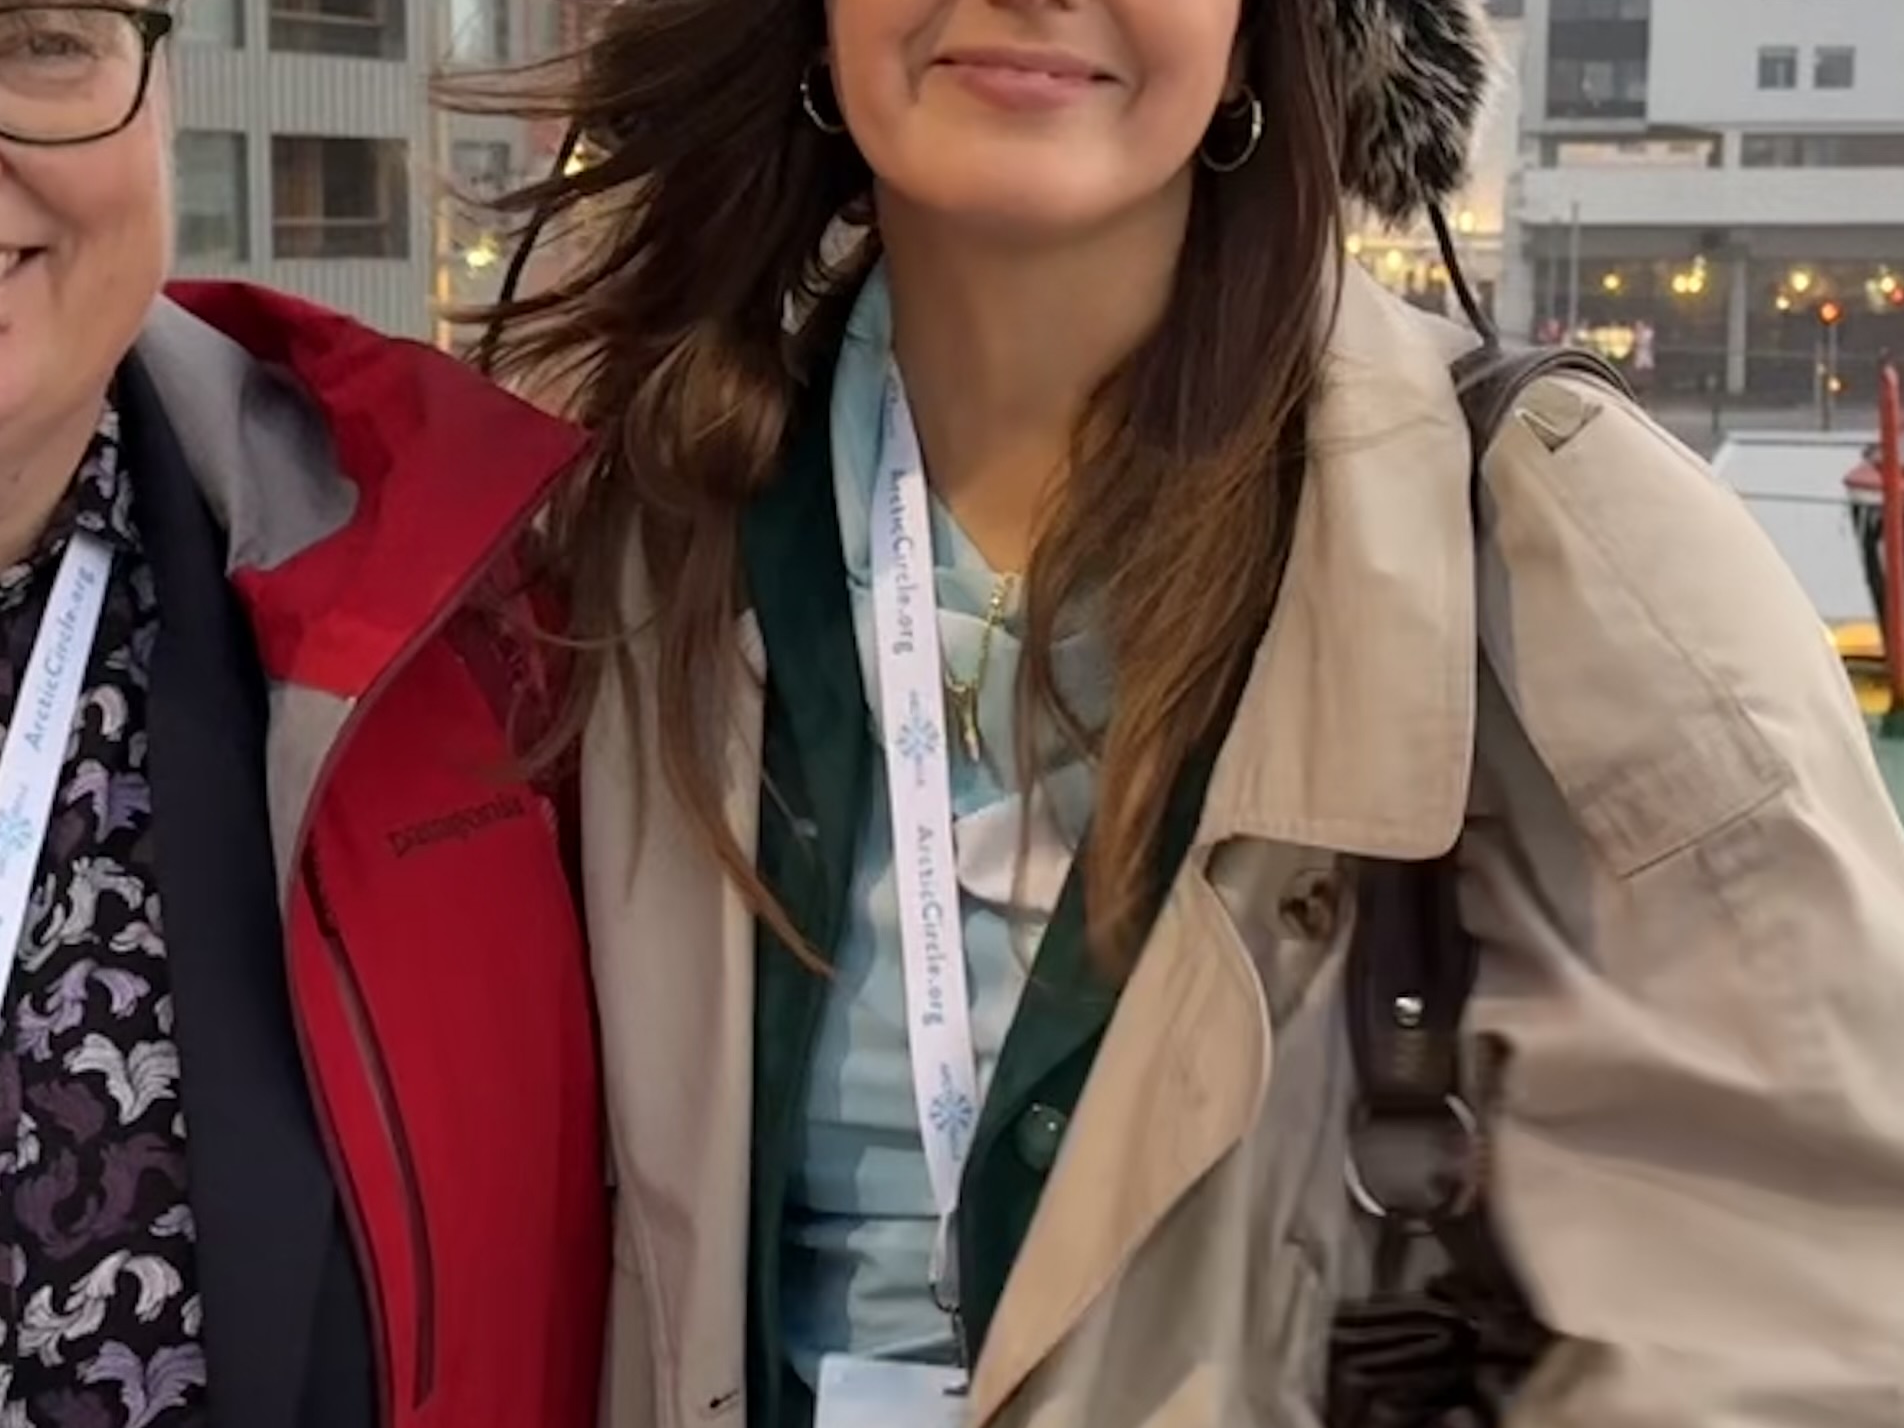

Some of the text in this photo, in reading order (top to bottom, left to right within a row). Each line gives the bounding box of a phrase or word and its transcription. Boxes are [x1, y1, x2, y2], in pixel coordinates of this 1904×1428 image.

[888, 467, 918, 655] ArcticCircle.org
[24, 564, 95, 753] ArcticCircle.org
[915, 823, 945, 1027] ArcticCircle.org
